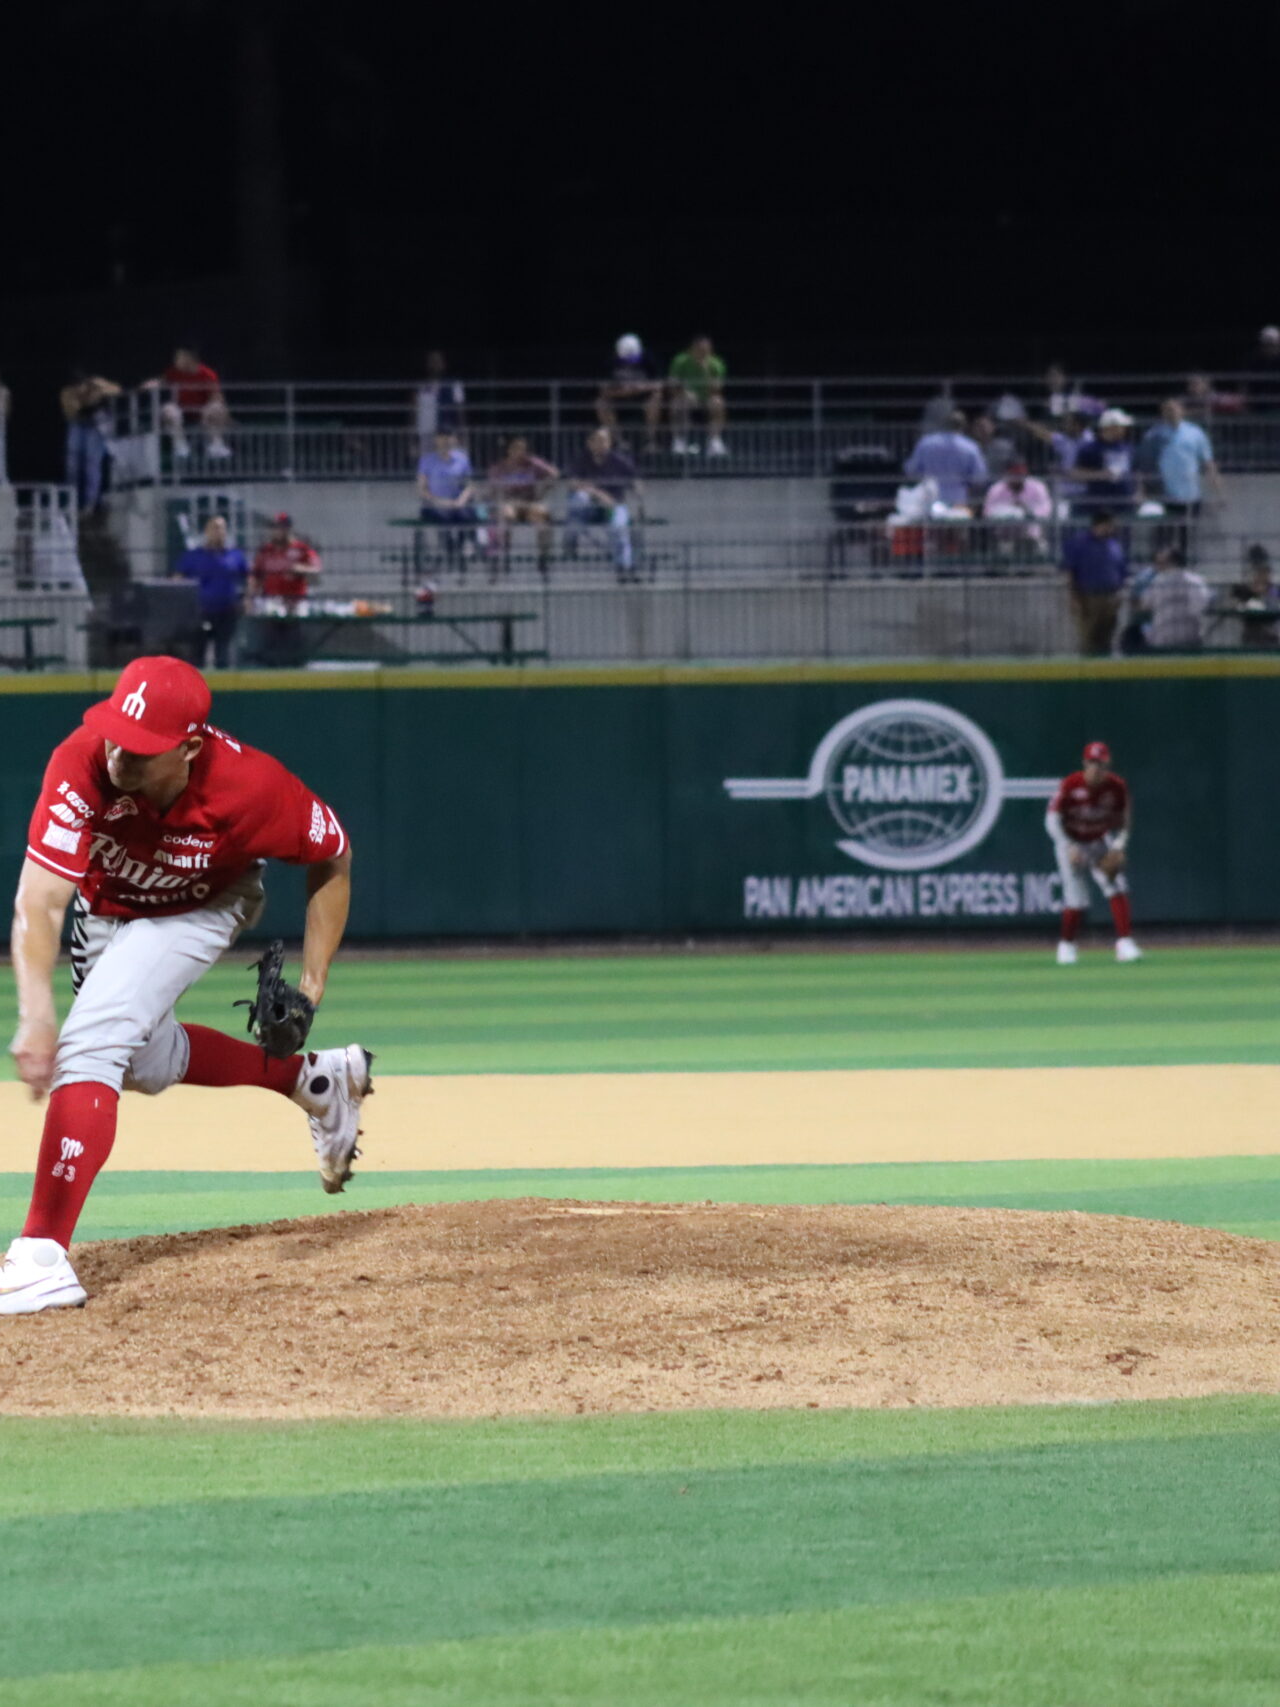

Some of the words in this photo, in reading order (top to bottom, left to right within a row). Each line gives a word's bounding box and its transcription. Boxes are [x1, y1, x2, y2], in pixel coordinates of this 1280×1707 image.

[843, 764, 973, 802] PANAMEX
[163, 834, 213, 848] codere
[744, 876, 790, 918] PAN
[794, 874, 914, 918] AMERICAN
[919, 873, 1019, 916] EXPRESS
